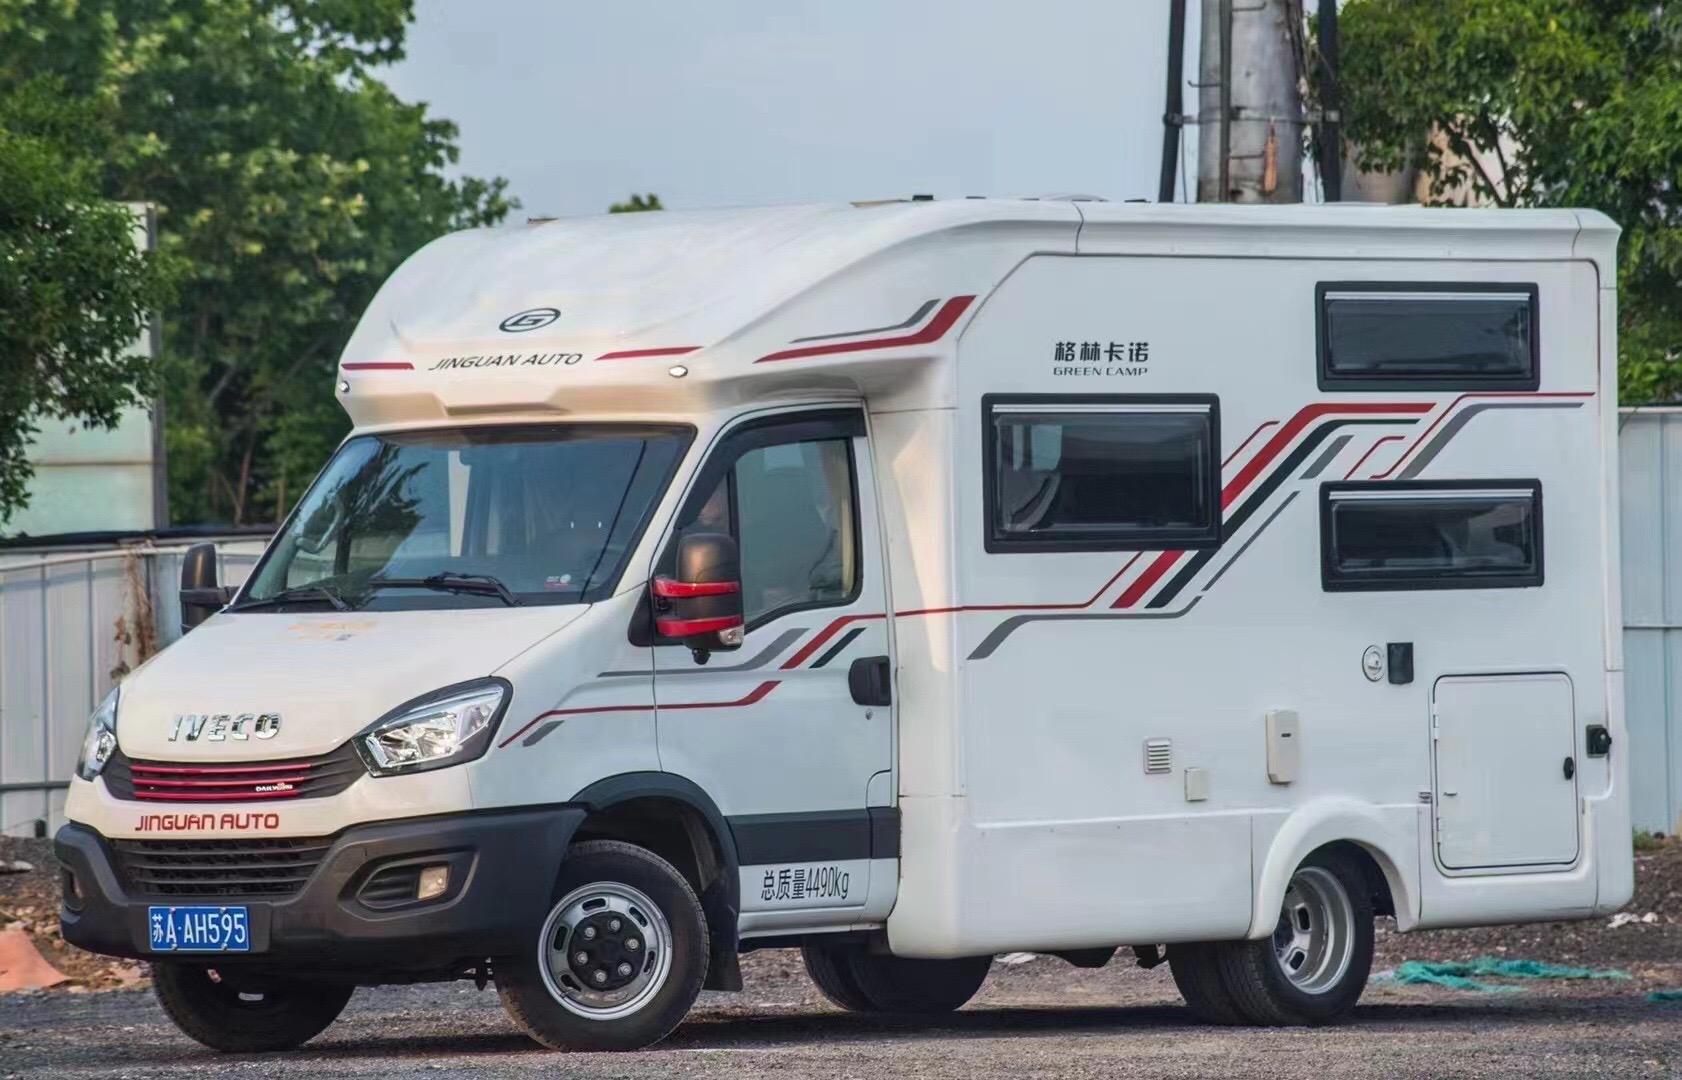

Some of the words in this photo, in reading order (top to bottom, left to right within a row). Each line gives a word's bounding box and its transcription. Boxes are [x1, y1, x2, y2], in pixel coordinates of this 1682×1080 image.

[428, 354, 517, 371] JINGUAN
[521, 352, 584, 367] AUTO
[1054, 341, 1150, 362] 格林卡诺
[1053, 367, 1102, 376] GREEN
[1106, 367, 1149, 376] CAMP
[168, 712, 282, 742] IVECO
[135, 814, 216, 831] JINGUAN
[220, 813, 280, 830] AUTO
[761, 866, 850, 900] 总质量4490kg
